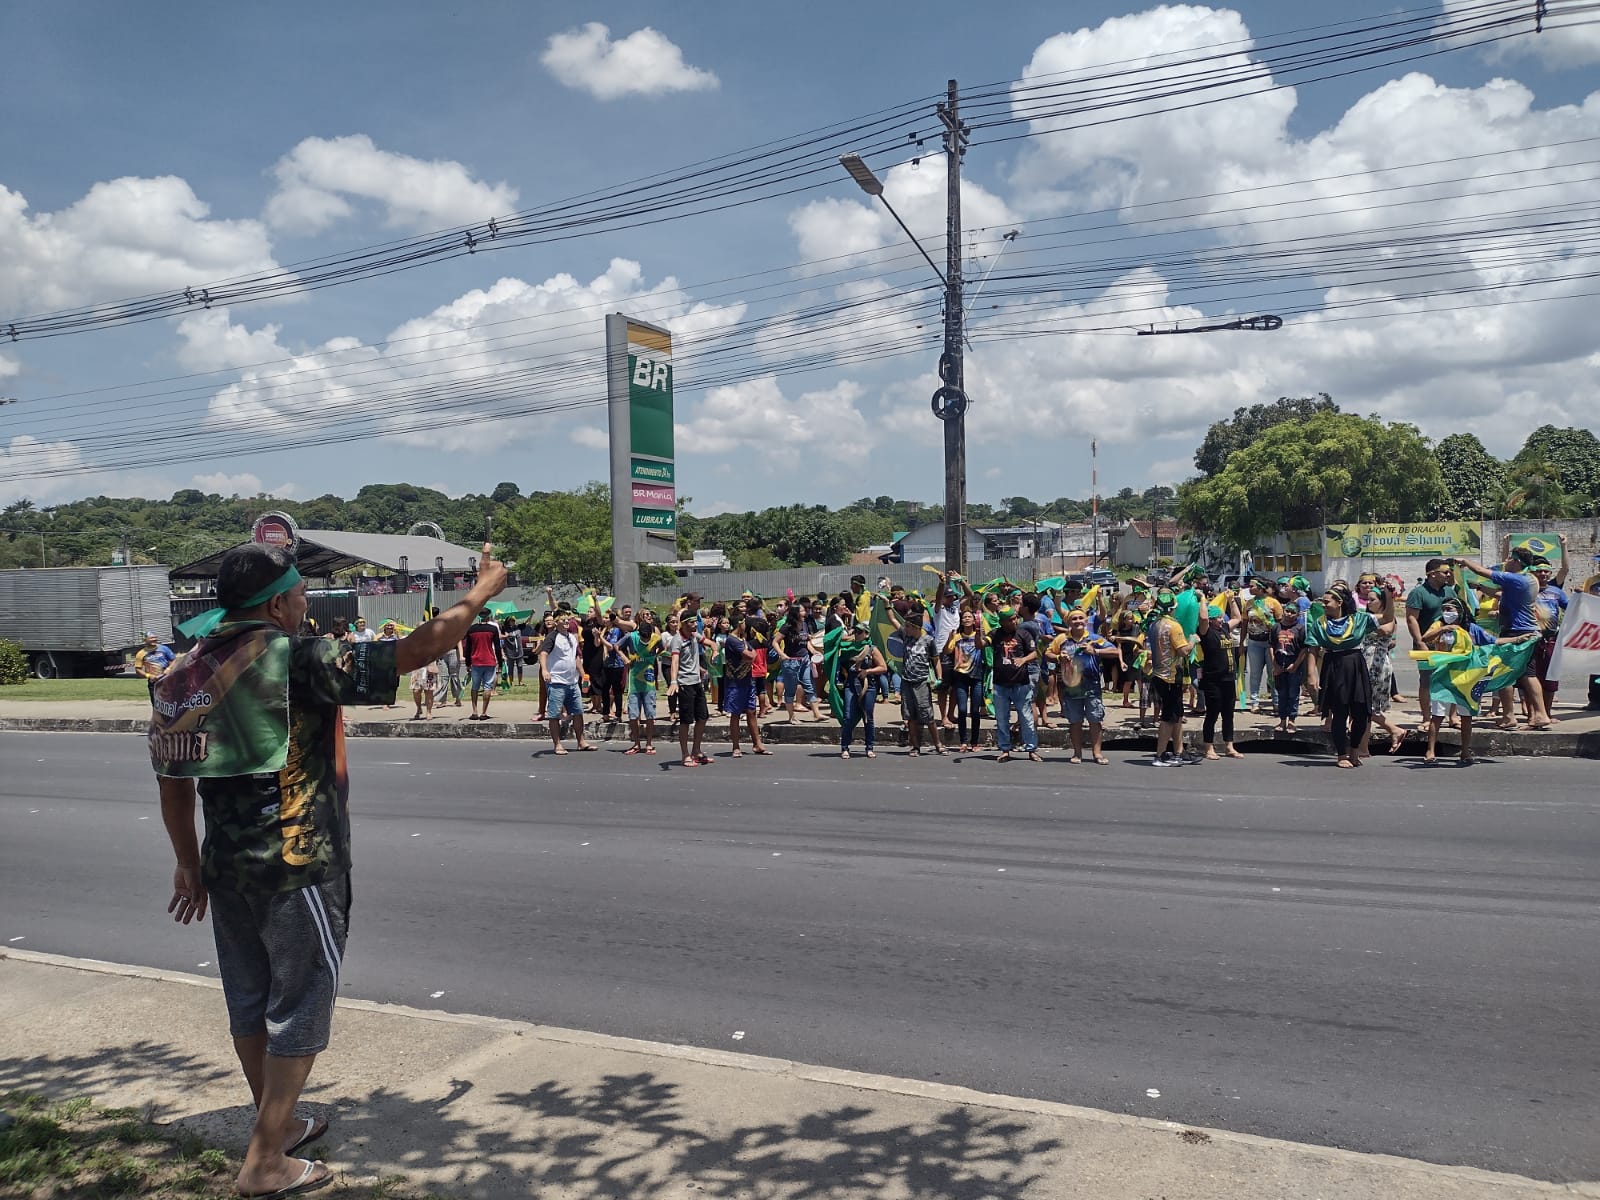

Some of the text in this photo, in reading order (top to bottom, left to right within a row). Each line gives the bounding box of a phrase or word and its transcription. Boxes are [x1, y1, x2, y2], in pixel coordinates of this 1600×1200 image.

[633, 356, 668, 392] BR
[633, 489, 673, 501] BR Mania
[636, 515, 665, 525] LUBRAX
[1367, 525, 1446, 534] MONTE DE ORAÇÃO
[1405, 533, 1453, 548] Shamá
